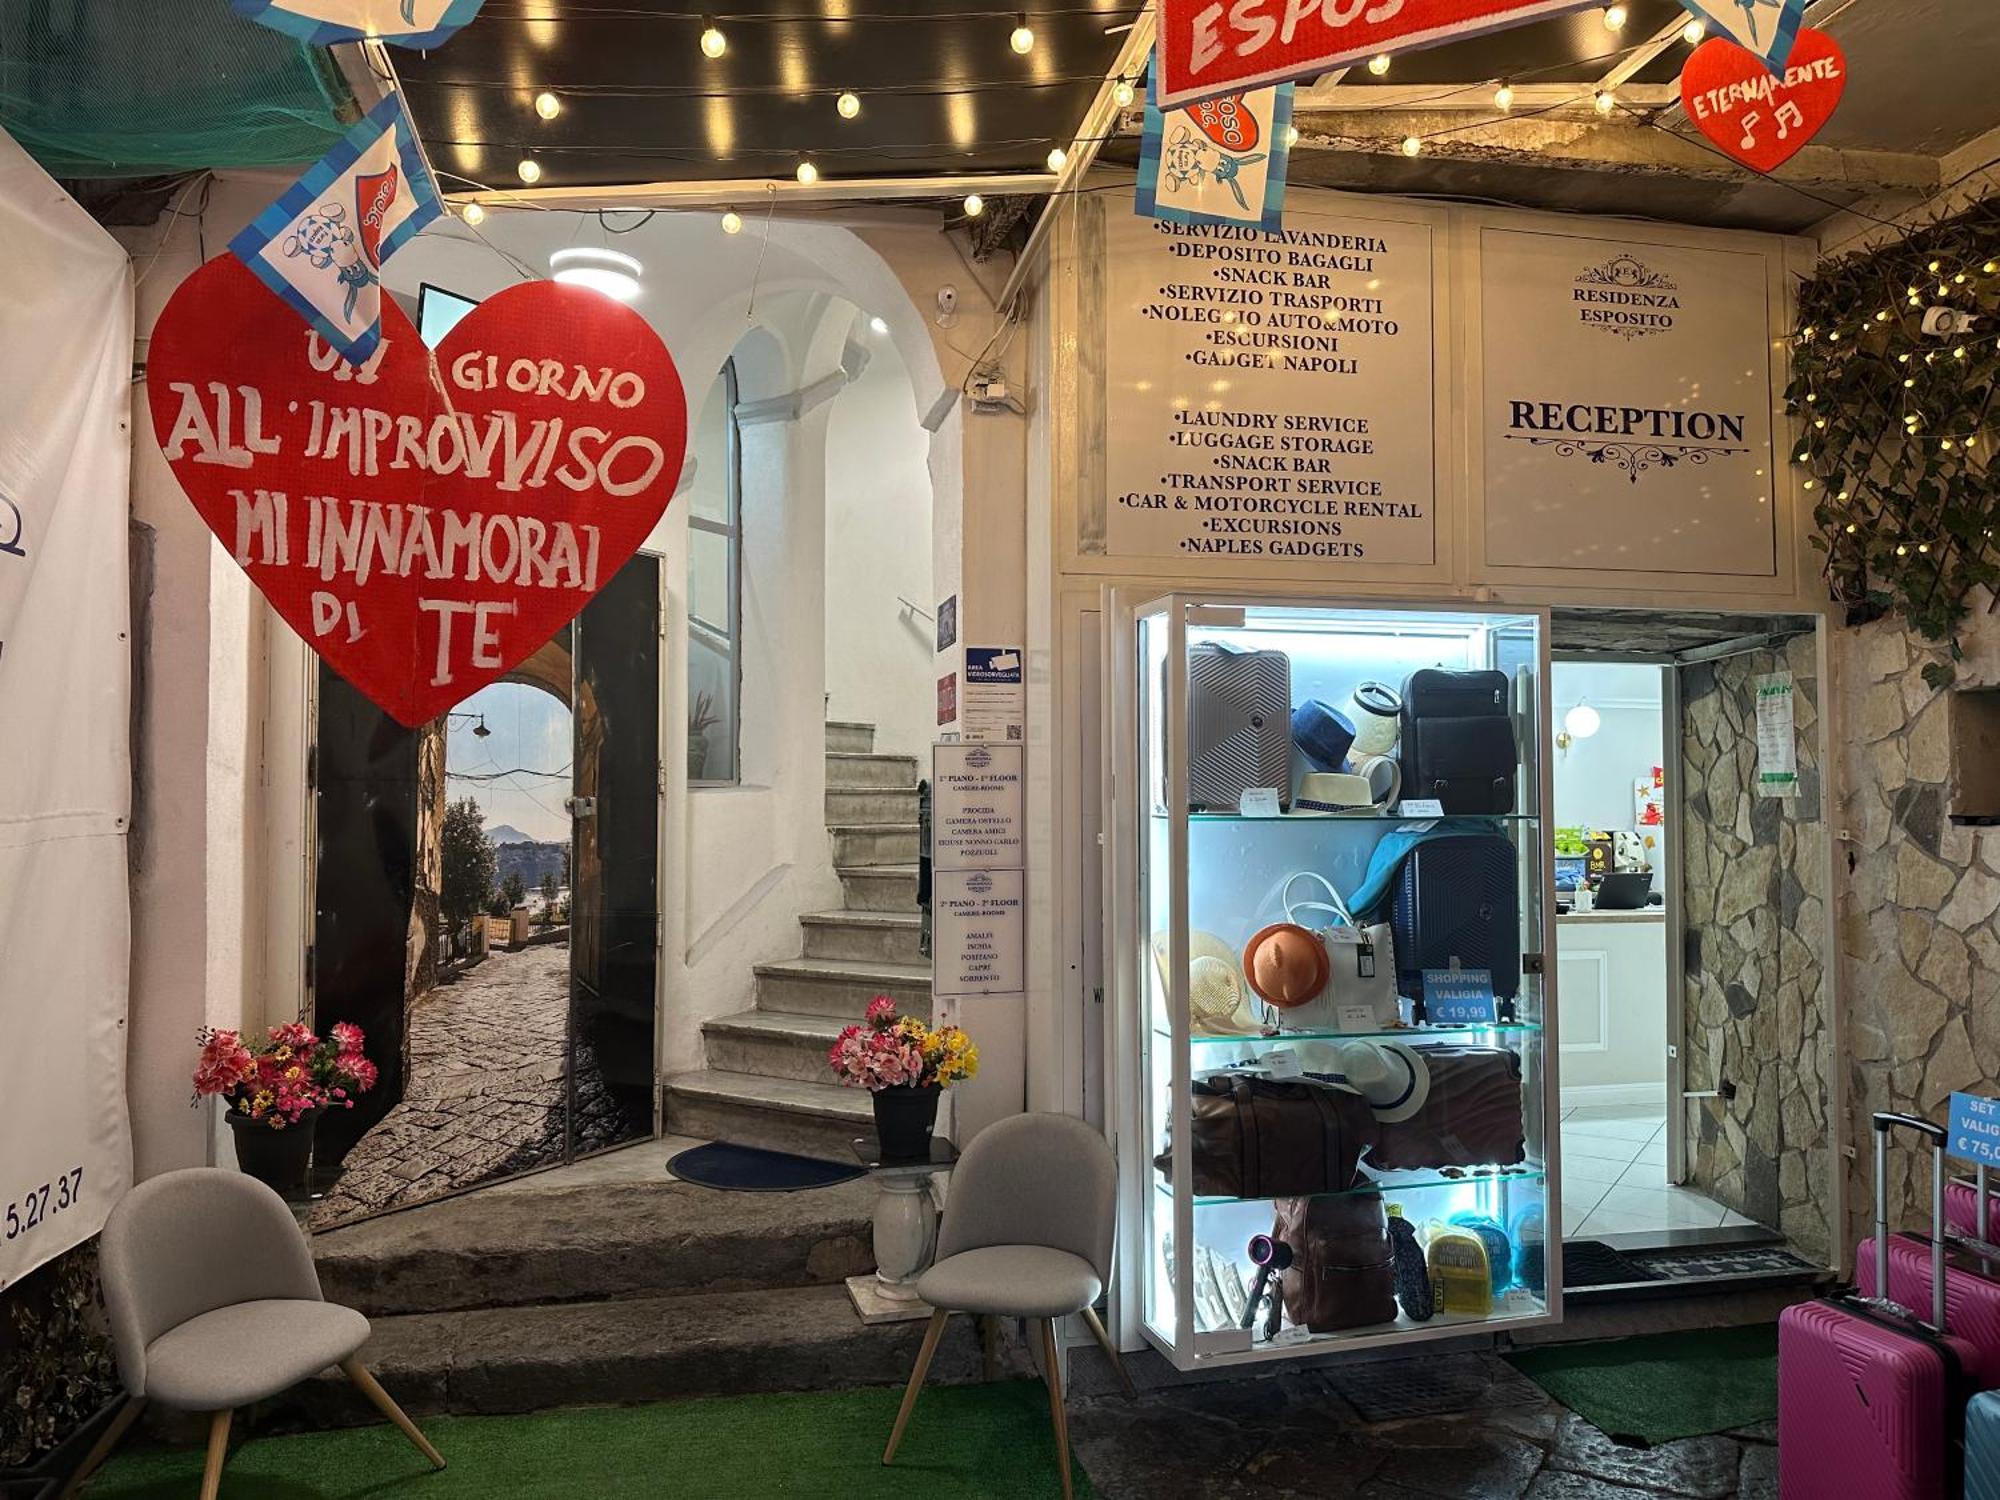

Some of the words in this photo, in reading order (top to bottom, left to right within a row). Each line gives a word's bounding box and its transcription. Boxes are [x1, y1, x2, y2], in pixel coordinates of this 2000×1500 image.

[1264, 230, 1387, 253] LAVANDERIA
[1288, 251, 1373, 272] BAGAGLI
[1292, 273, 1331, 289] BAR
[1269, 292, 1383, 314] TRASPORTI
[1572, 288, 1680, 309] RESIDENZA
[1267, 313, 1398, 335] AUTO&MOTO
[1580, 309, 1673, 328] ESPOSITO
[1283, 357, 1358, 374] NAPOLI
[452, 350, 645, 408] GIORNO
[1284, 416, 1368, 434] SERVICE
[1509, 400, 1744, 442] RECEPTION
[1281, 436, 1374, 455] STORAGE
[1293, 458, 1331, 474] BAR
[1297, 478, 1382, 496] SERVICE
[1174, 495, 1188, 510] &
[1194, 496, 1338, 516] MOTORCYCLE
[1344, 502, 1422, 518] RENTAL
[227, 489, 289, 567] MI
[304, 496, 601, 592] INNAMORAI
[1269, 540, 1364, 558] GADGETS
[310, 591, 369, 643] DI
[418, 597, 518, 686] TE
[1426, 973, 1488, 984] SHOPPING
[1435, 990, 1483, 999] VALIGIA
[1449, 1006, 1486, 1018] 19,99
[1969, 1100, 1996, 1115] SET
[1961, 1116, 2000, 1137] VALIG
[1957, 1138, 1968, 1150] €
